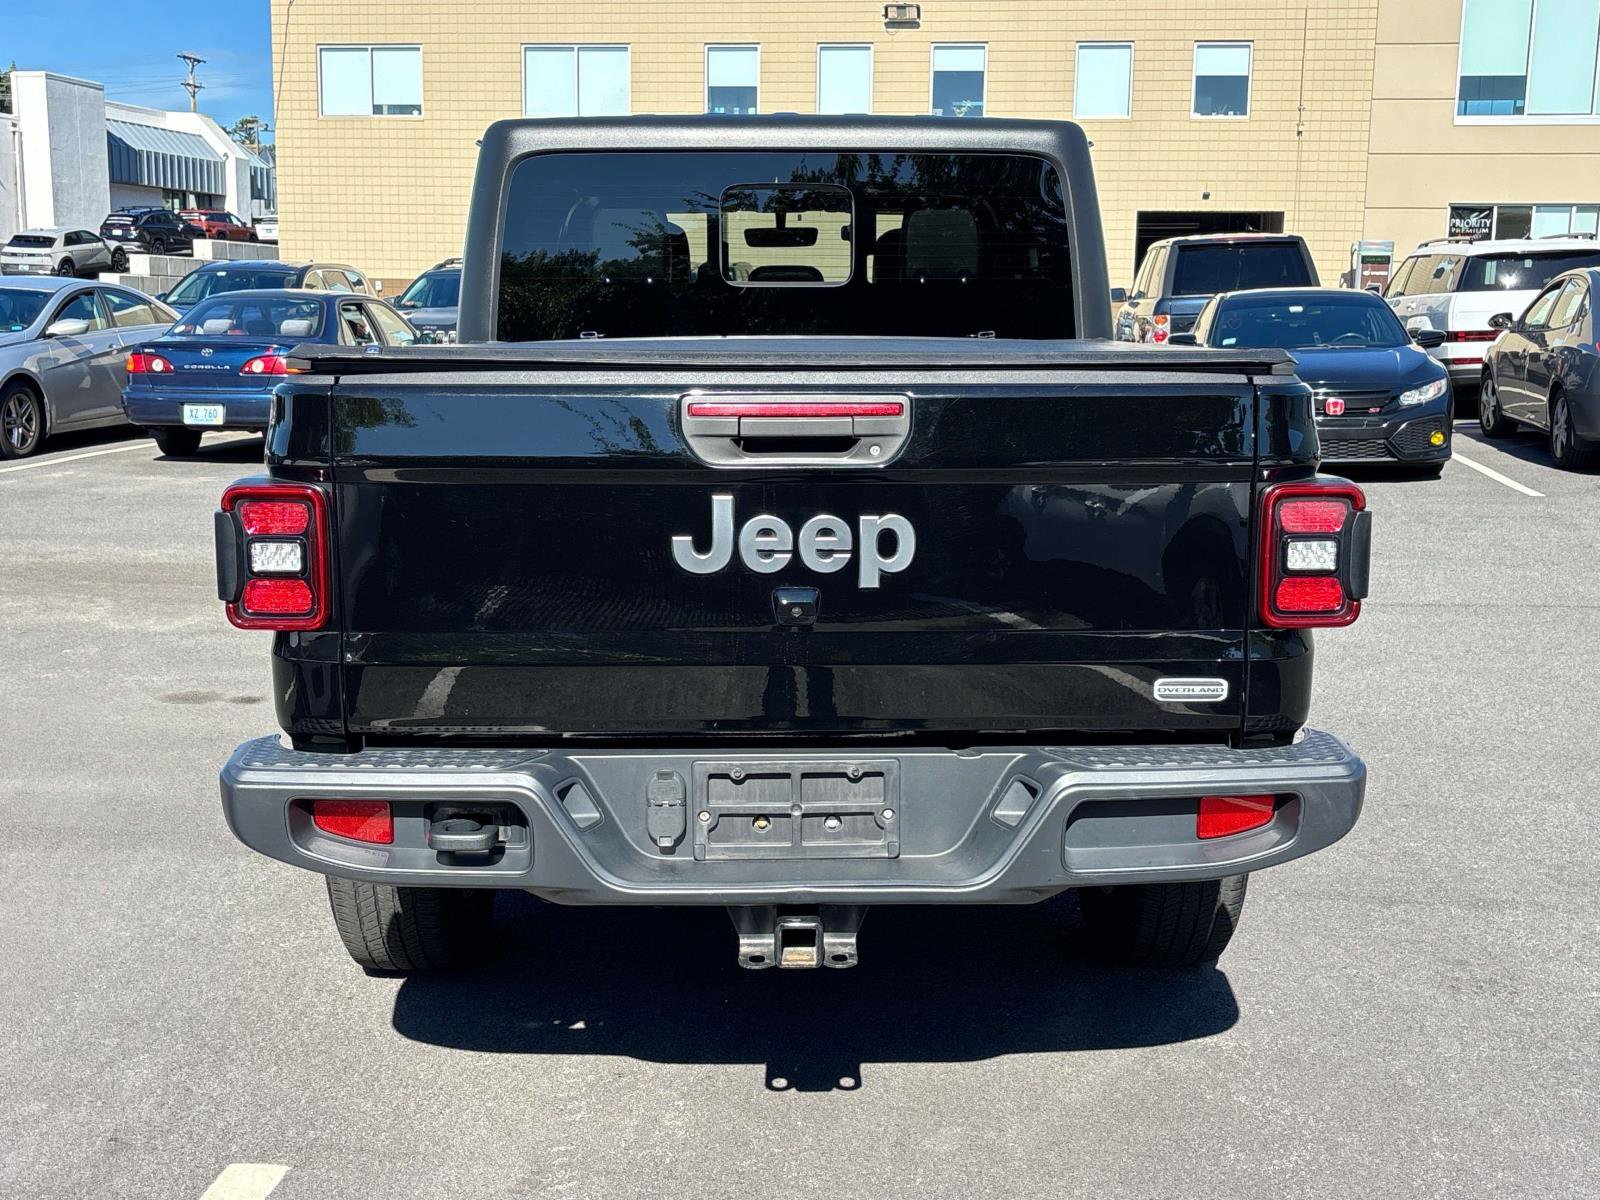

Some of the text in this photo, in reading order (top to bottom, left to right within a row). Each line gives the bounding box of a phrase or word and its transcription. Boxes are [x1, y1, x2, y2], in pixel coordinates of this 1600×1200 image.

[1450, 218, 1492, 228] PRIORITY
[189, 408, 218, 419] XZ 760
[671, 495, 917, 589] Jeep
